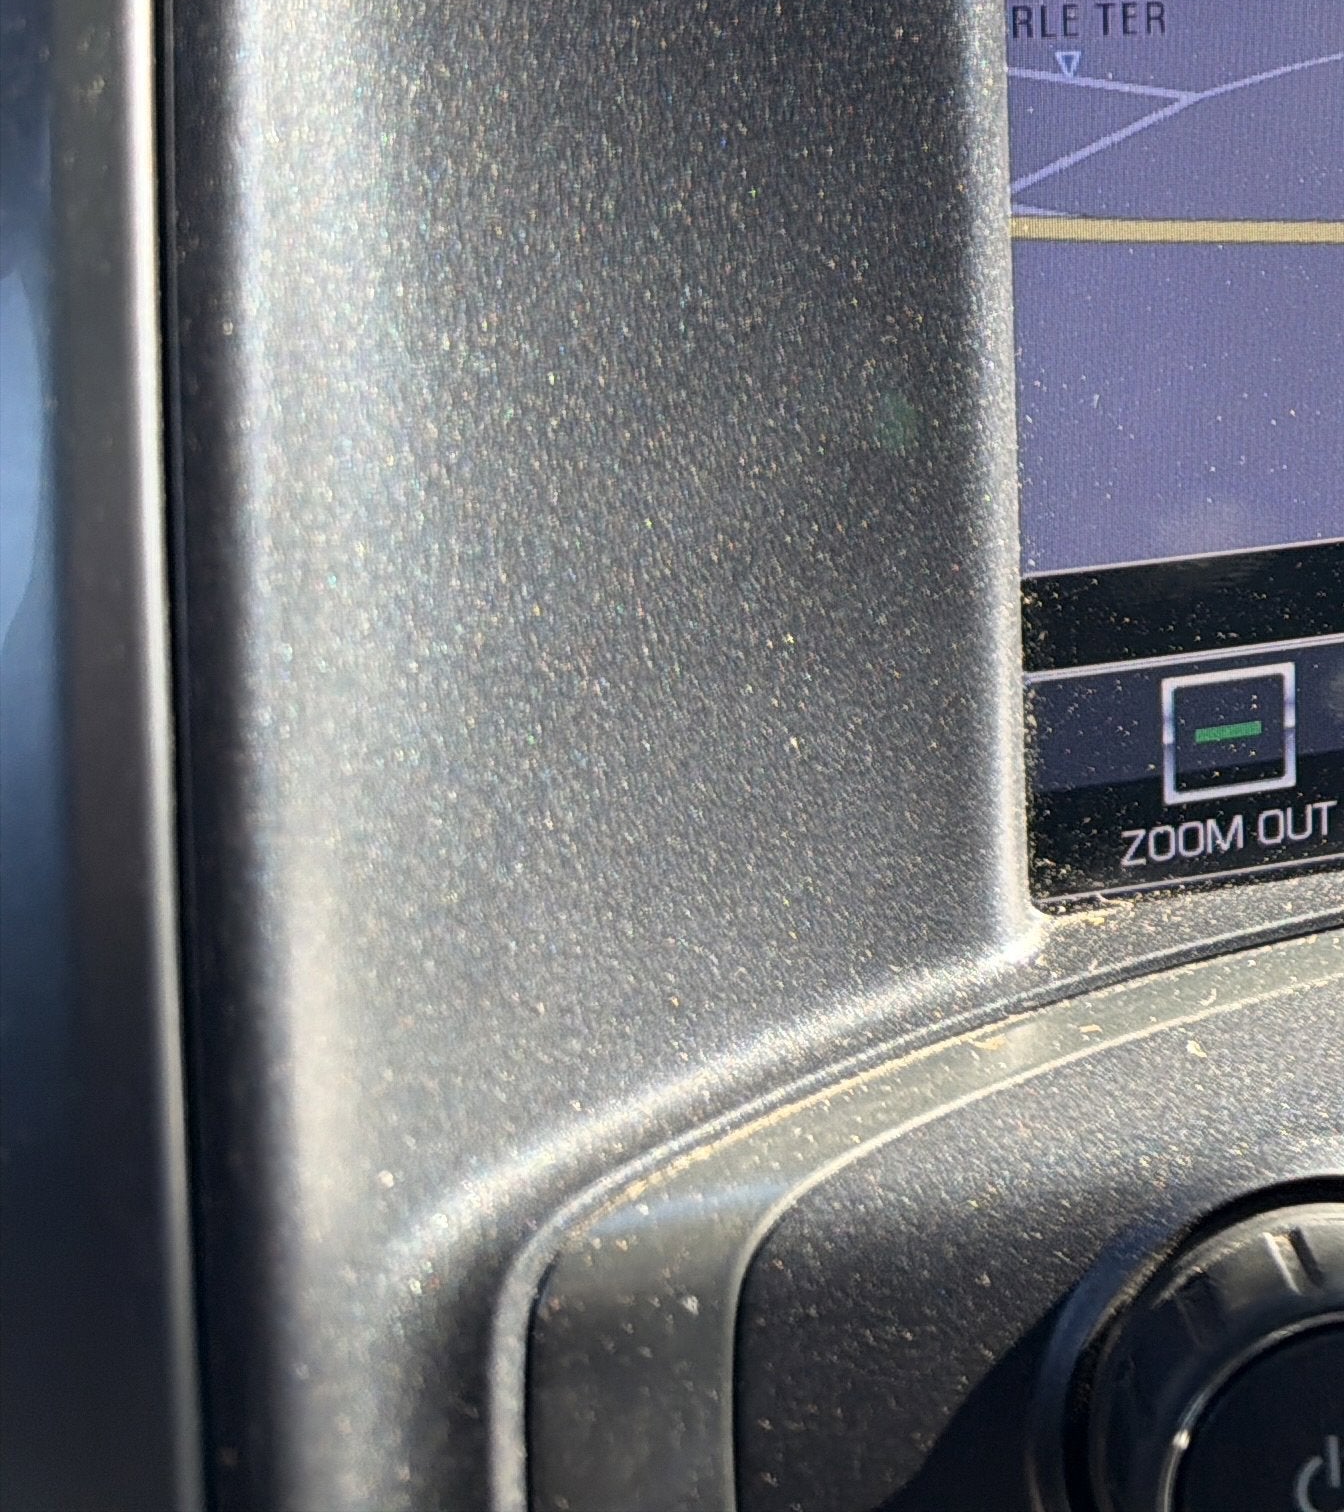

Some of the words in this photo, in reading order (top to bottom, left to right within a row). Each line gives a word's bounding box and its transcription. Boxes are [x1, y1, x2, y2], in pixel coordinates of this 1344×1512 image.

[1095, 1, 1166, 36] TER
[1121, 815, 1245, 866] ZOOM
[1258, 800, 1338, 847] OUT
